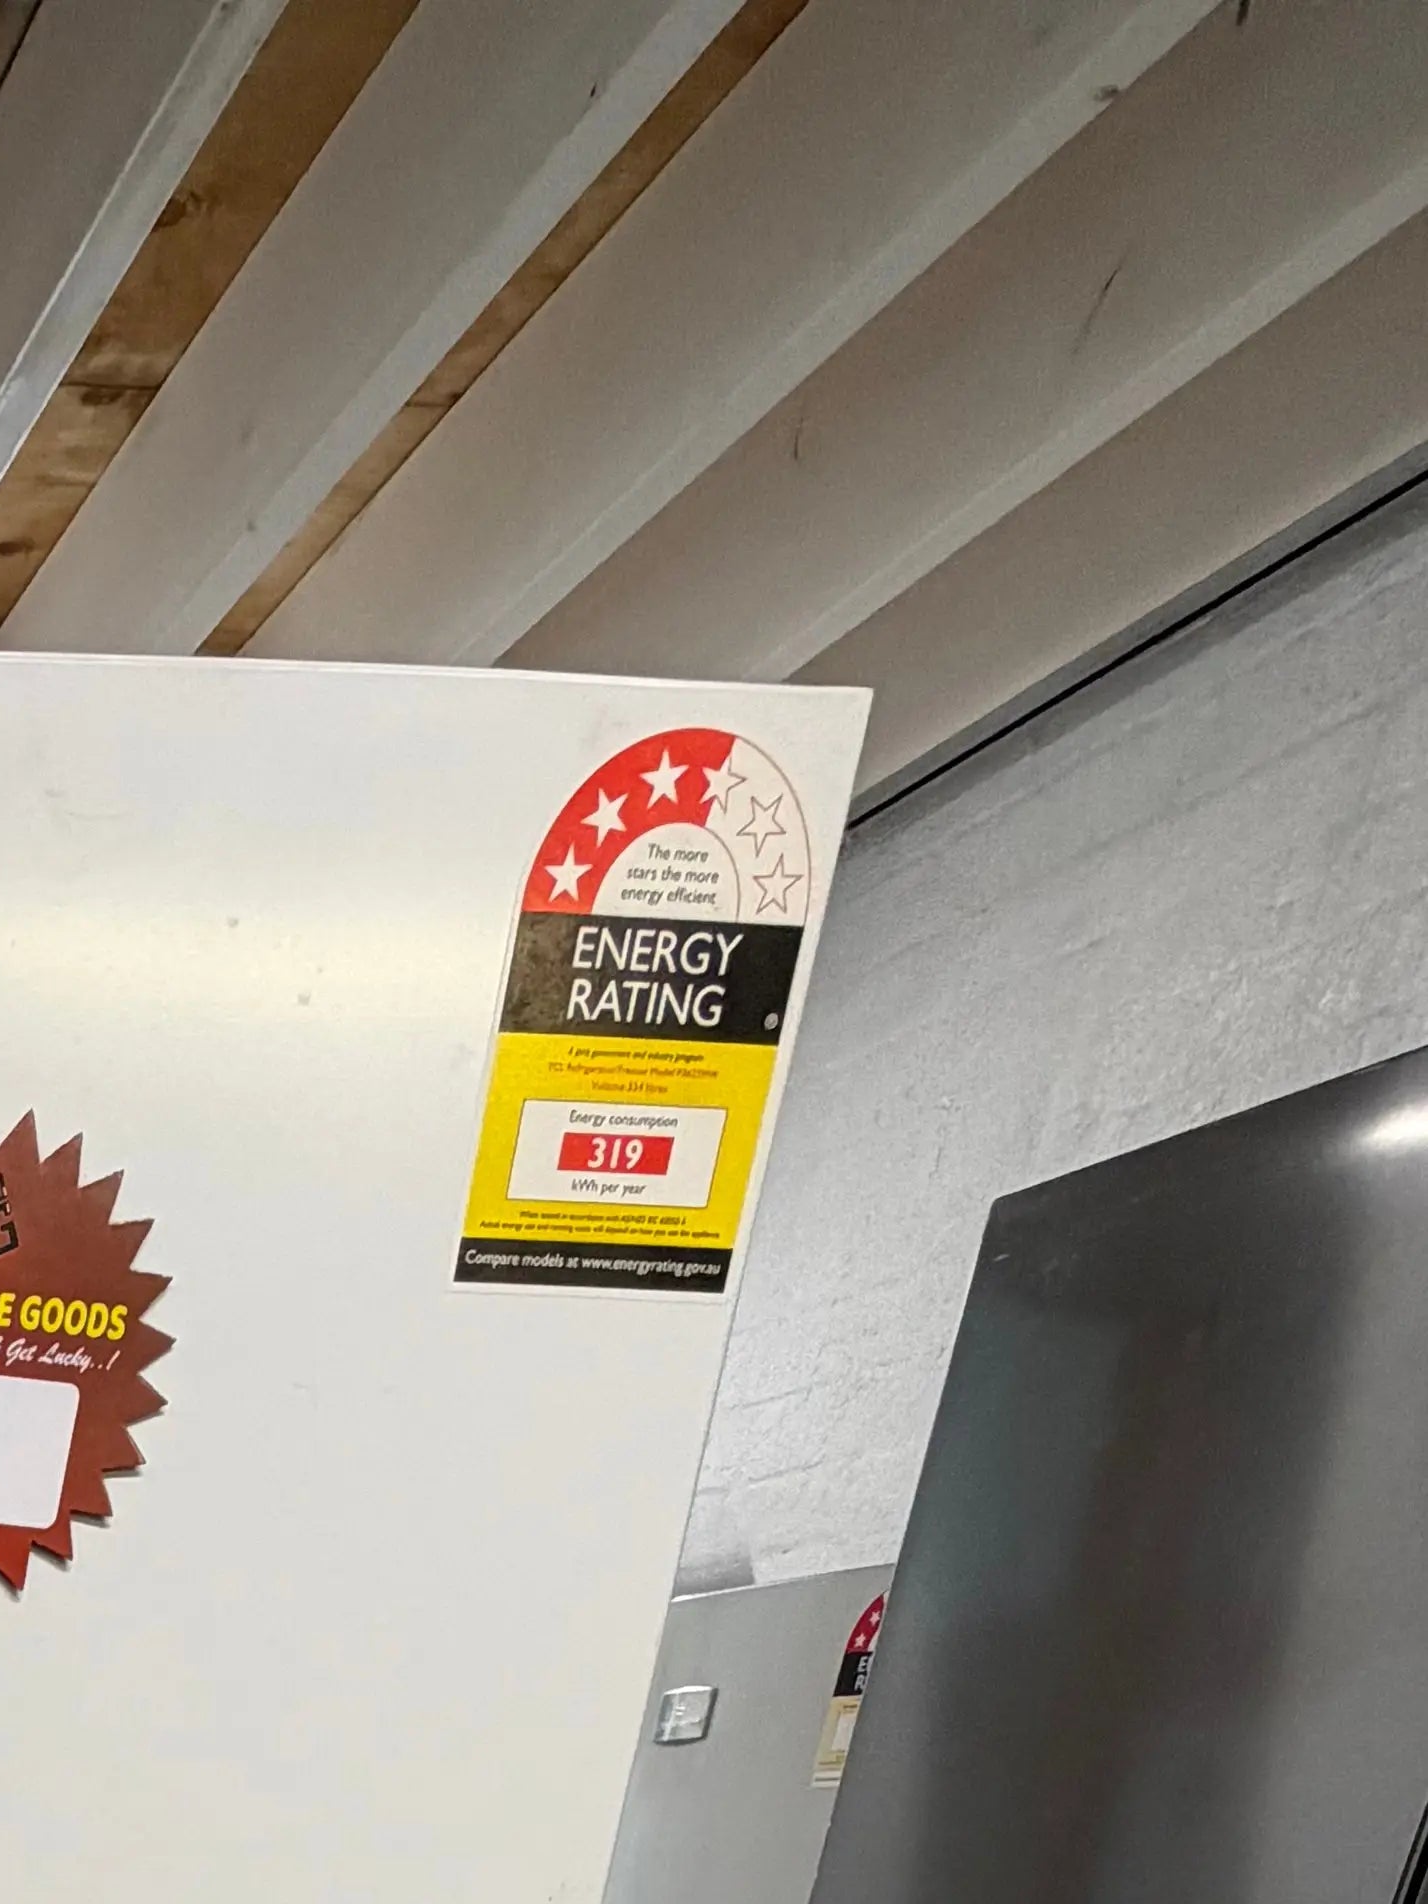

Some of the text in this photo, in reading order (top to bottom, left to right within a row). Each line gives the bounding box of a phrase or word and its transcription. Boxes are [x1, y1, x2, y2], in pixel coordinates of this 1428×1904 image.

[648, 843, 708, 863] The more
[626, 866, 719, 885] stars the more
[621, 886, 716, 905] energy efficient
[572, 926, 744, 976] ENERGY
[566, 978, 726, 1028] RATING
[569, 1109, 678, 1130] Energy consumption
[587, 1136, 644, 1170] 319
[571, 1178, 647, 1197] kWh per year
[465, 1249, 720, 1277] Compare models at www.energyrating.gov.au
[19, 1296, 129, 1342] GOODS
[5, 1339, 36, 1364] Get
